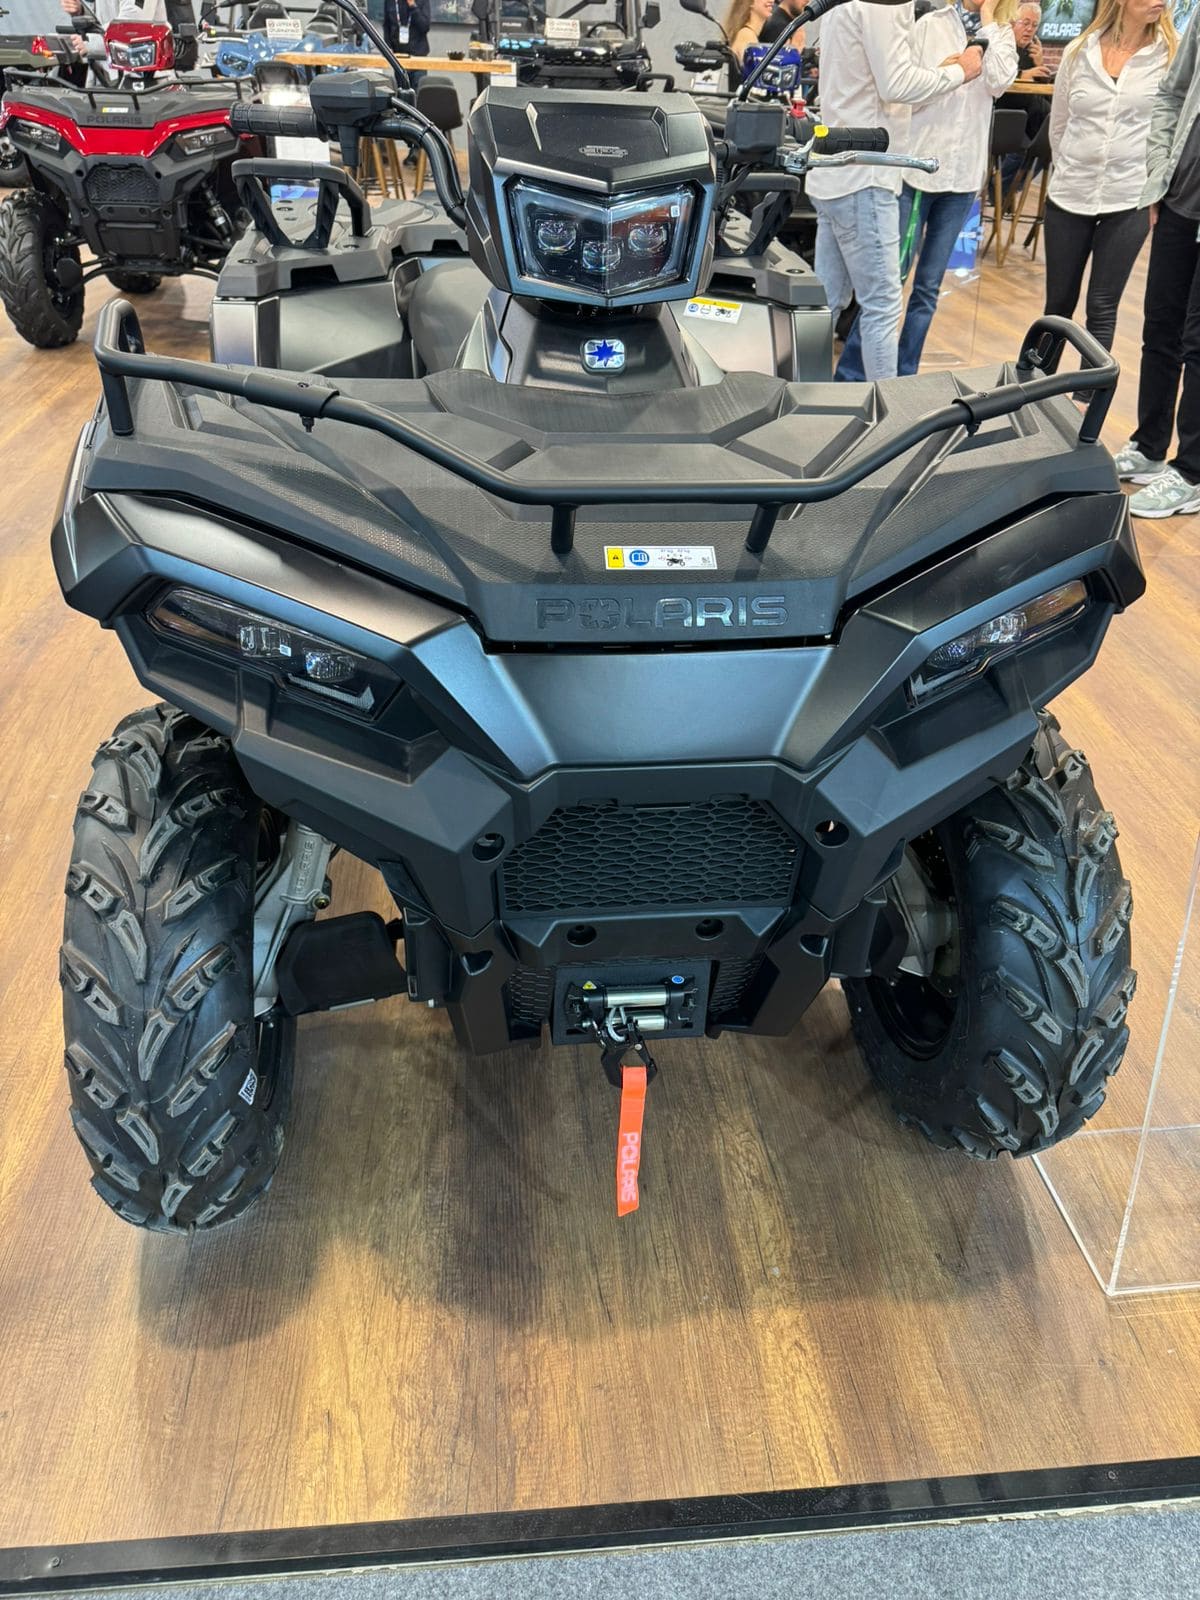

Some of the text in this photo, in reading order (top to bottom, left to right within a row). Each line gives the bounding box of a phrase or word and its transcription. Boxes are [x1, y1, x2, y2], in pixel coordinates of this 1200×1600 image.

[1042, 23, 1082, 37] POLARIS
[87, 116, 142, 124] POLARIS
[536, 596, 788, 629] POLARIS
[620, 1133, 639, 1202] POLARIS
